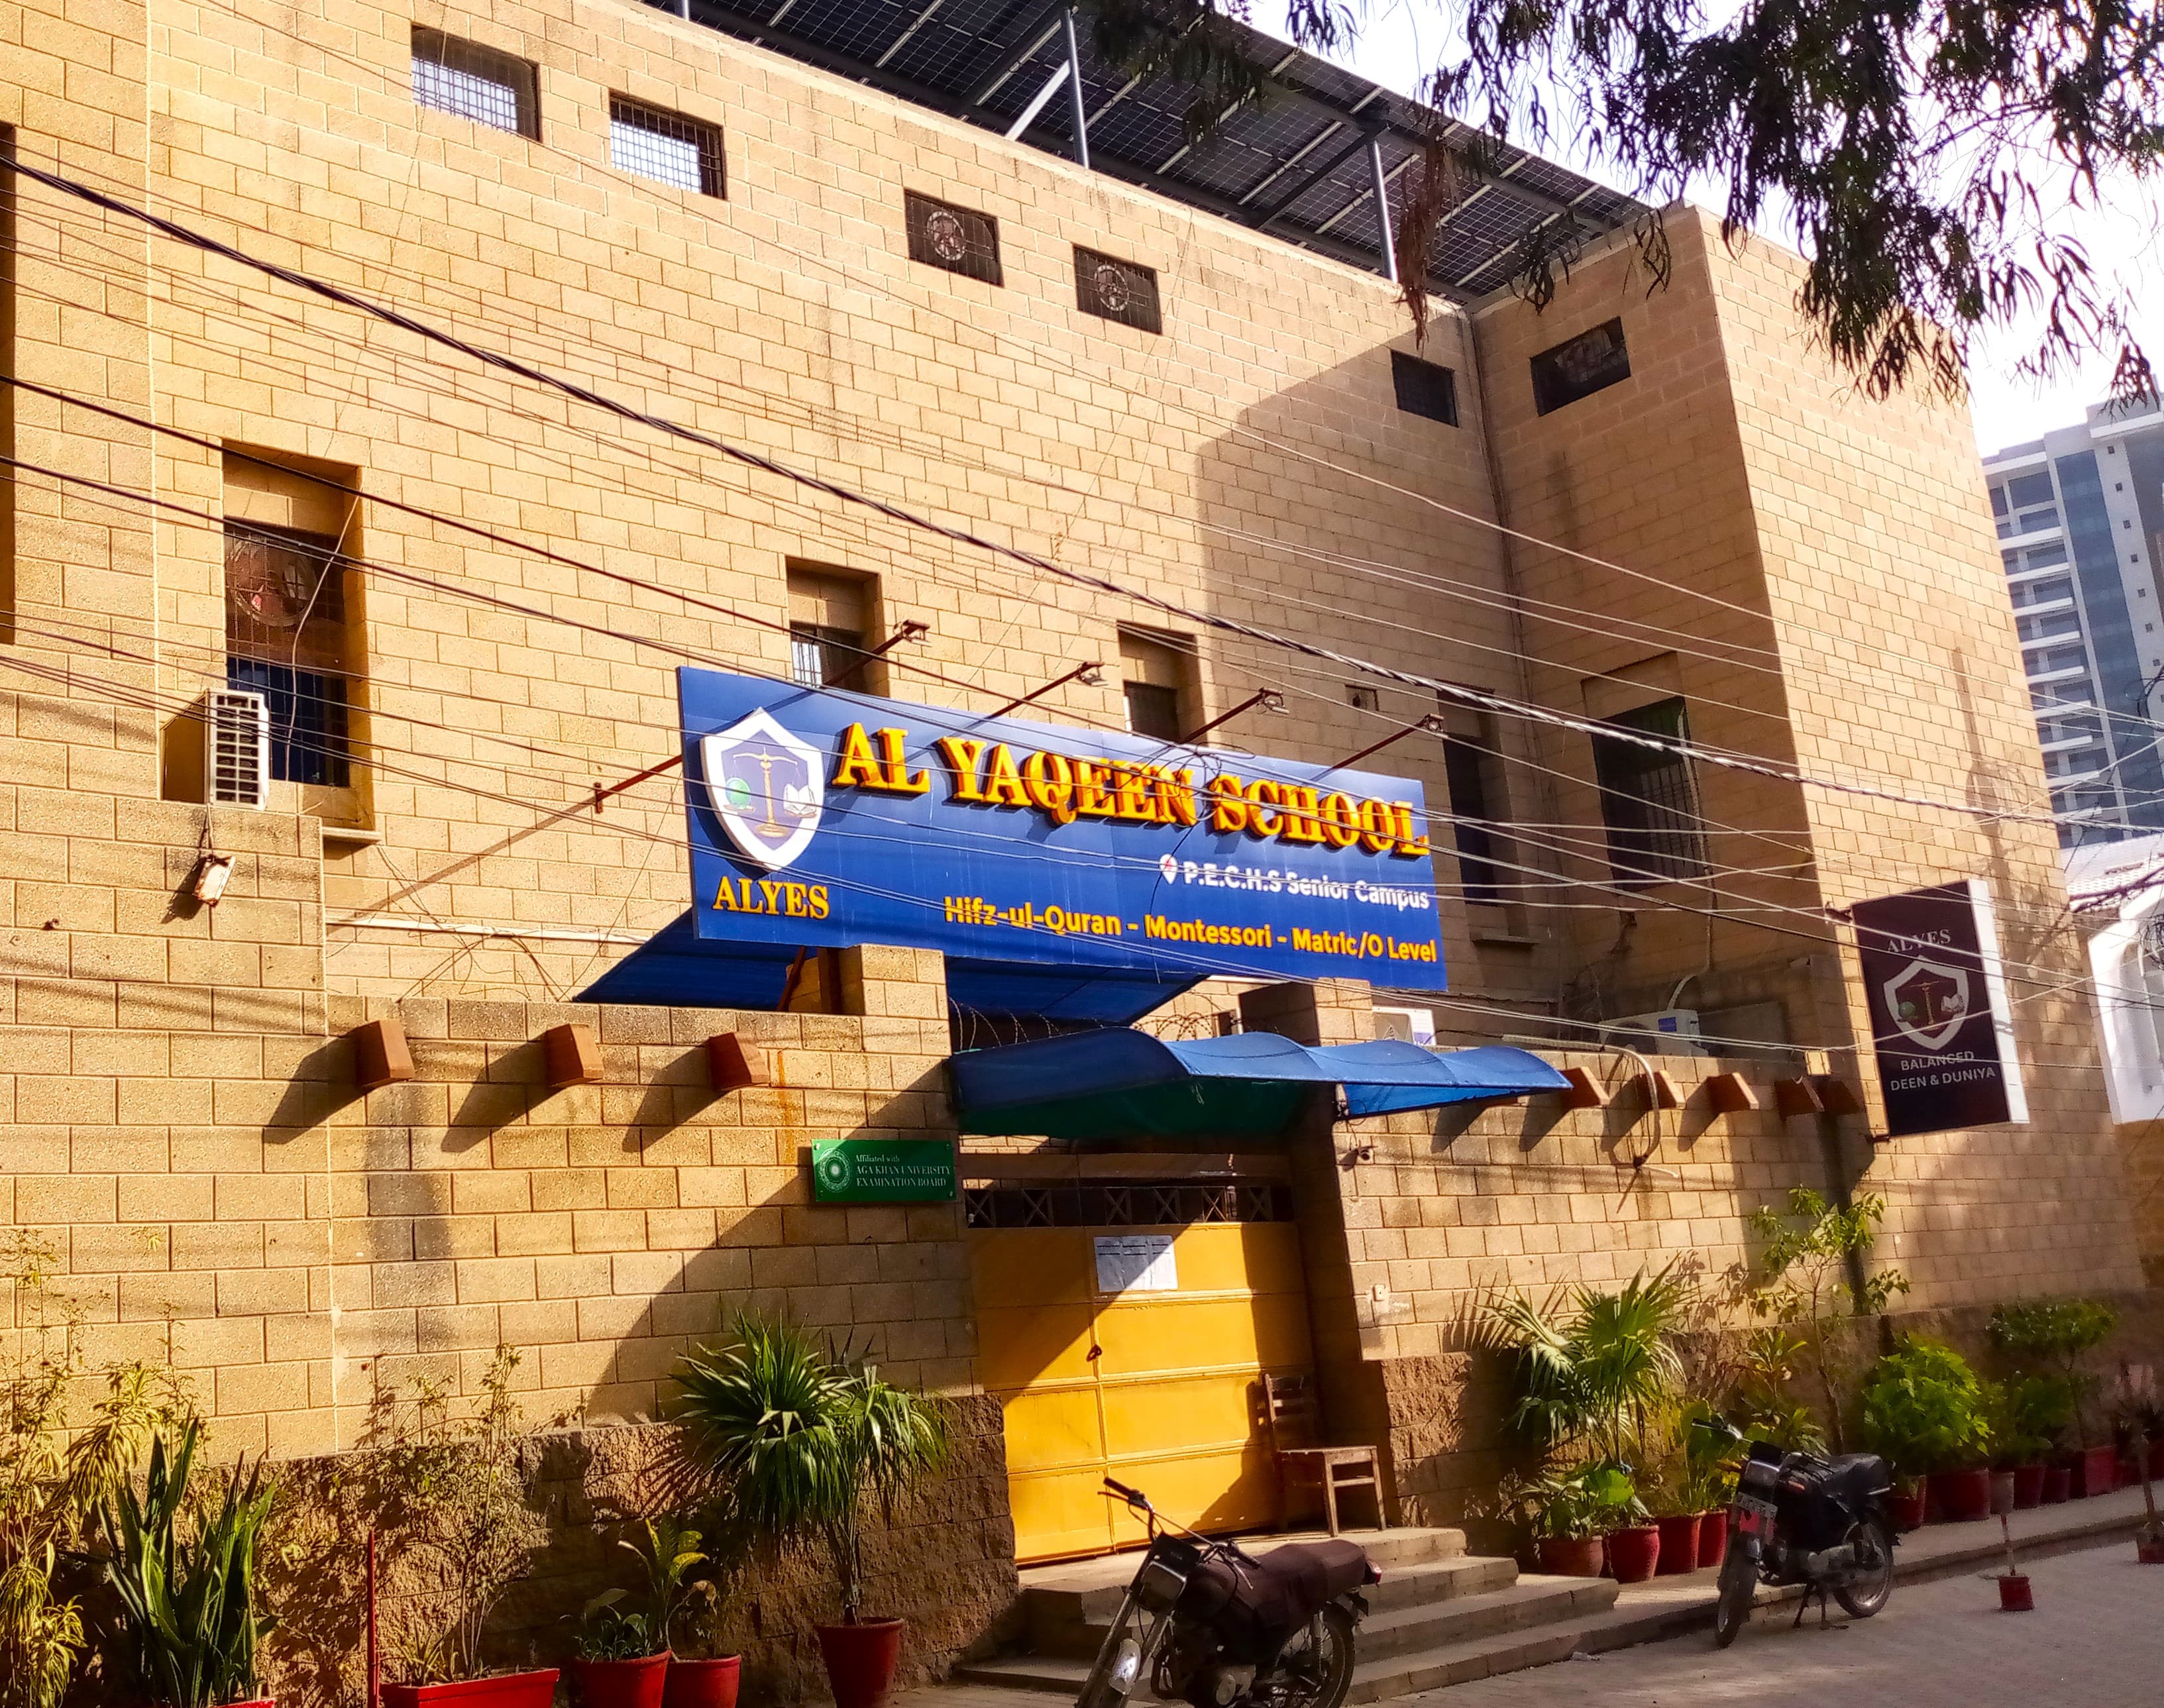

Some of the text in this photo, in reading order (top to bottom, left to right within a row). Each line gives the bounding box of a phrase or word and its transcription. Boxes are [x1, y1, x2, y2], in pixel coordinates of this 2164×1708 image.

[831, 721, 1431, 857] AL YAQEEN SCHOOL
[712, 875, 830, 920] ALYES
[1183, 861, 1431, 912] P.E.C.H.S Senior Campus
[944, 895, 1122, 935] Hifz-ul-Quran
[1144, 914, 1272, 948] Montessori
[1291, 928, 1384, 959] Matric/O
[1387, 937, 1438, 963] Level
[1887, 929, 1951, 953] ALYES
[1900, 1051, 1975, 1071] BALANCED
[1890, 1067, 1996, 1091] DEEN & DUNIYA
[855, 1154, 885, 1163] Affiliated
[857, 1165, 950, 1175] AGA KHAN UNIVERSITY
[856, 1177, 946, 1187] EXAMINATION BOARD
